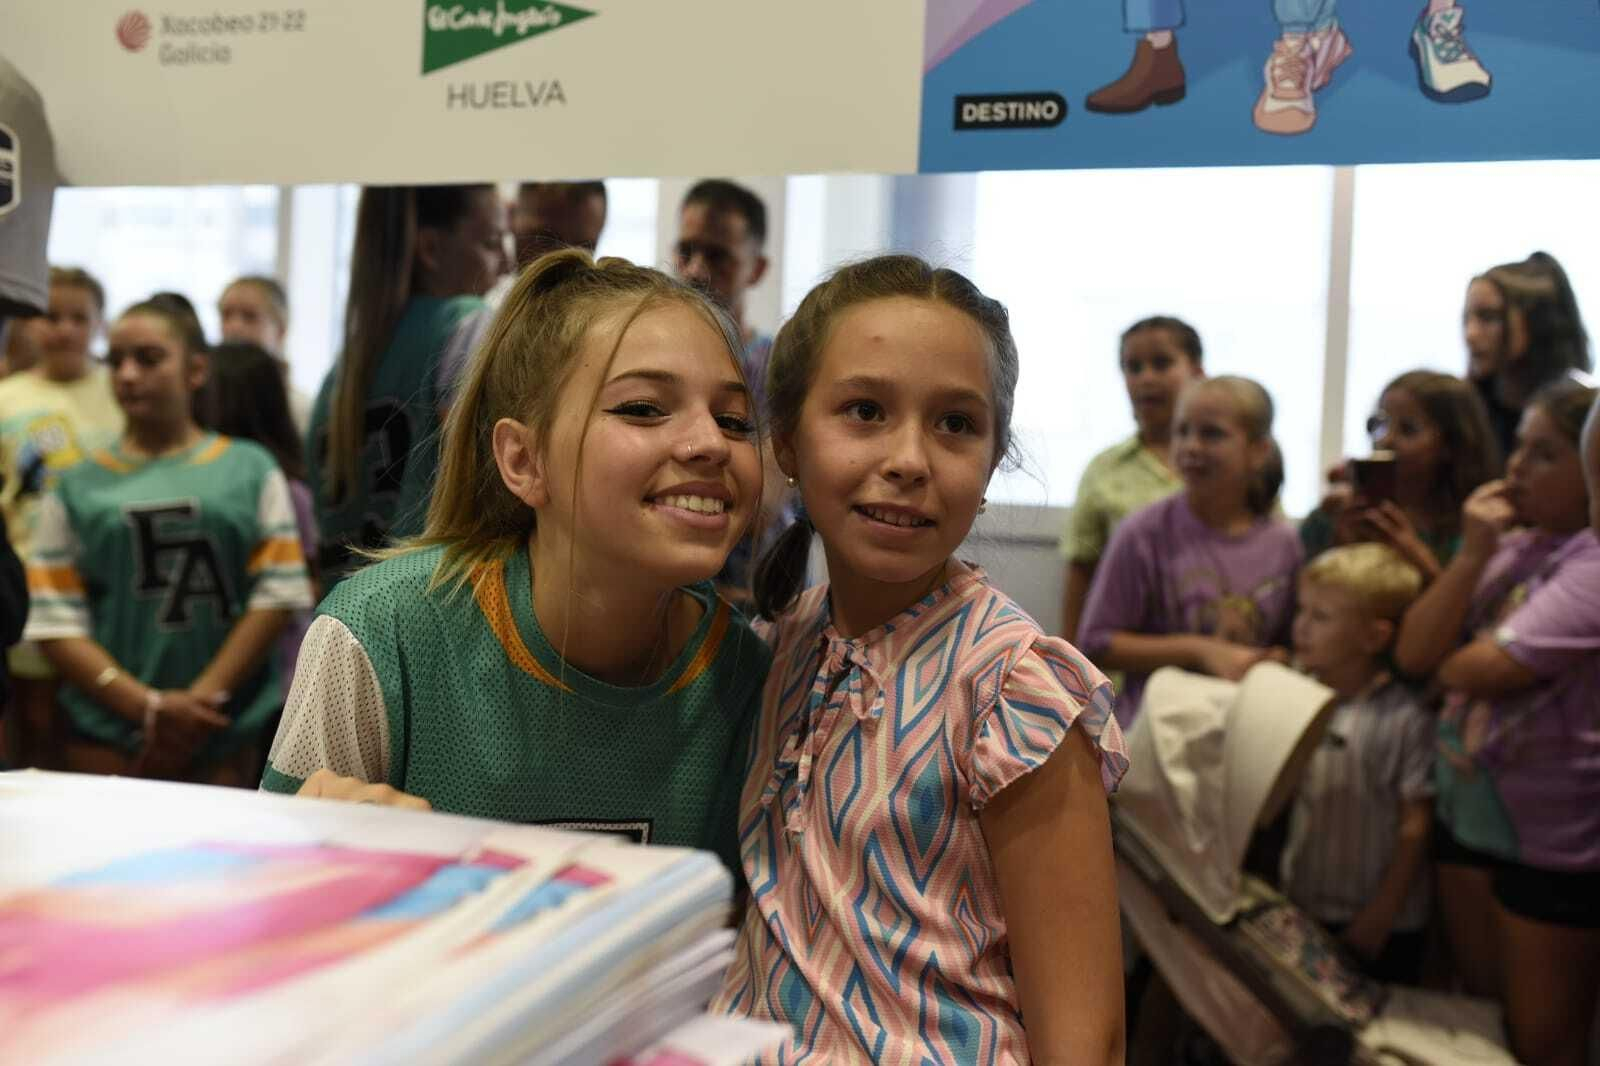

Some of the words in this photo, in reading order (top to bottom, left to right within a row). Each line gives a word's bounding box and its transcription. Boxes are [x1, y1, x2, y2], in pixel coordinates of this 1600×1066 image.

[159, 12, 254, 35] Xacobeo
[159, 43, 231, 65] Galicia
[447, 80, 566, 109] HUELVA
[962, 100, 1059, 122] DESTINO
